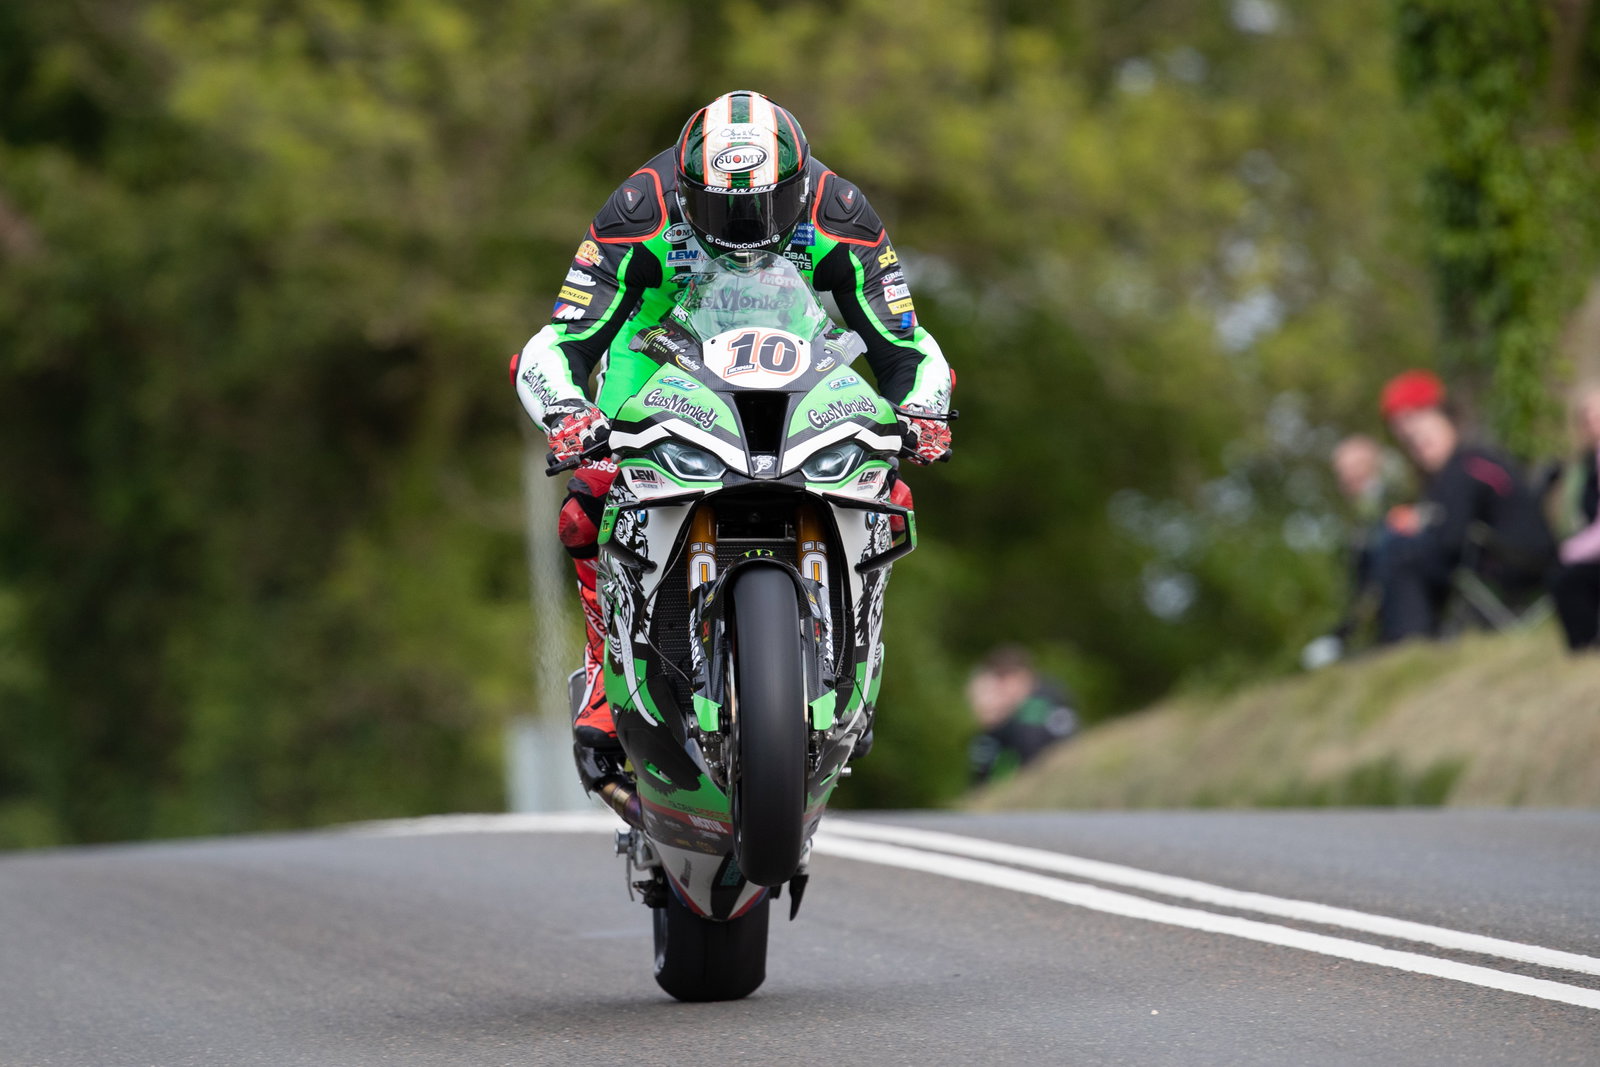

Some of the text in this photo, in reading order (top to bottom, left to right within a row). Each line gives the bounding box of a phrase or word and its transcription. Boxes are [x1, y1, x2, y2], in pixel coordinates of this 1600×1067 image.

[718, 154, 762, 164] SUOMY
[667, 229, 691, 237] SUOM
[714, 238, 771, 249] CasinoCoin.im
[667, 250, 699, 261] LEW
[783, 252, 811, 261] OBAL
[878, 246, 898, 269] sb
[725, 332, 798, 376] 10
[644, 389, 718, 429] GasMonkey
[808, 398, 877, 429] GasMonkey
[629, 469, 656, 481] LEW
[858, 471, 881, 483] LEW
